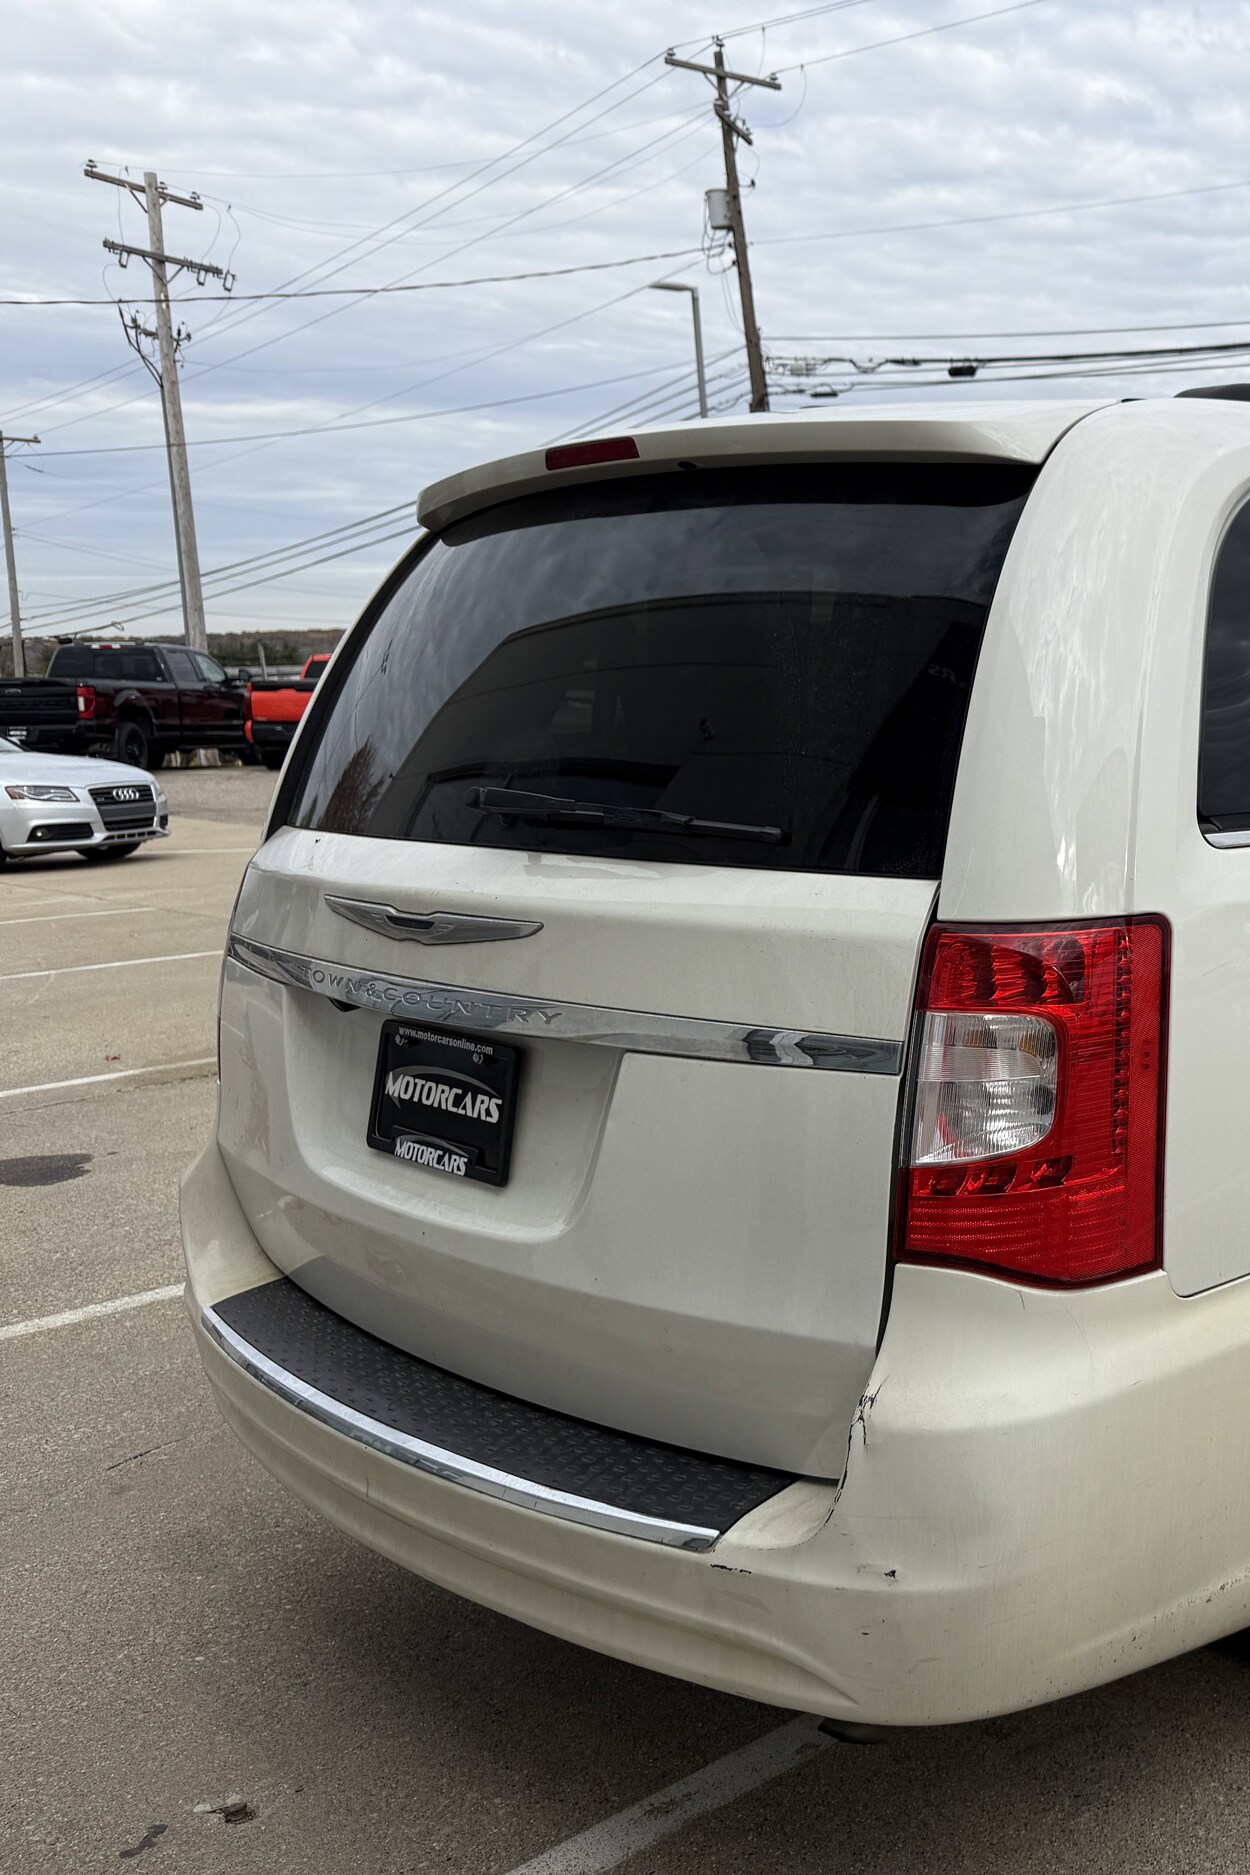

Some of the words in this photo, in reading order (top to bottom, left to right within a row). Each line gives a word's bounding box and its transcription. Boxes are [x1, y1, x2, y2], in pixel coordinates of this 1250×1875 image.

[398, 1026, 494, 1056] www.motorcarsonline.com
[385, 1071, 503, 1124] MOTORCARS
[394, 1139, 469, 1177] MOTORCARS
